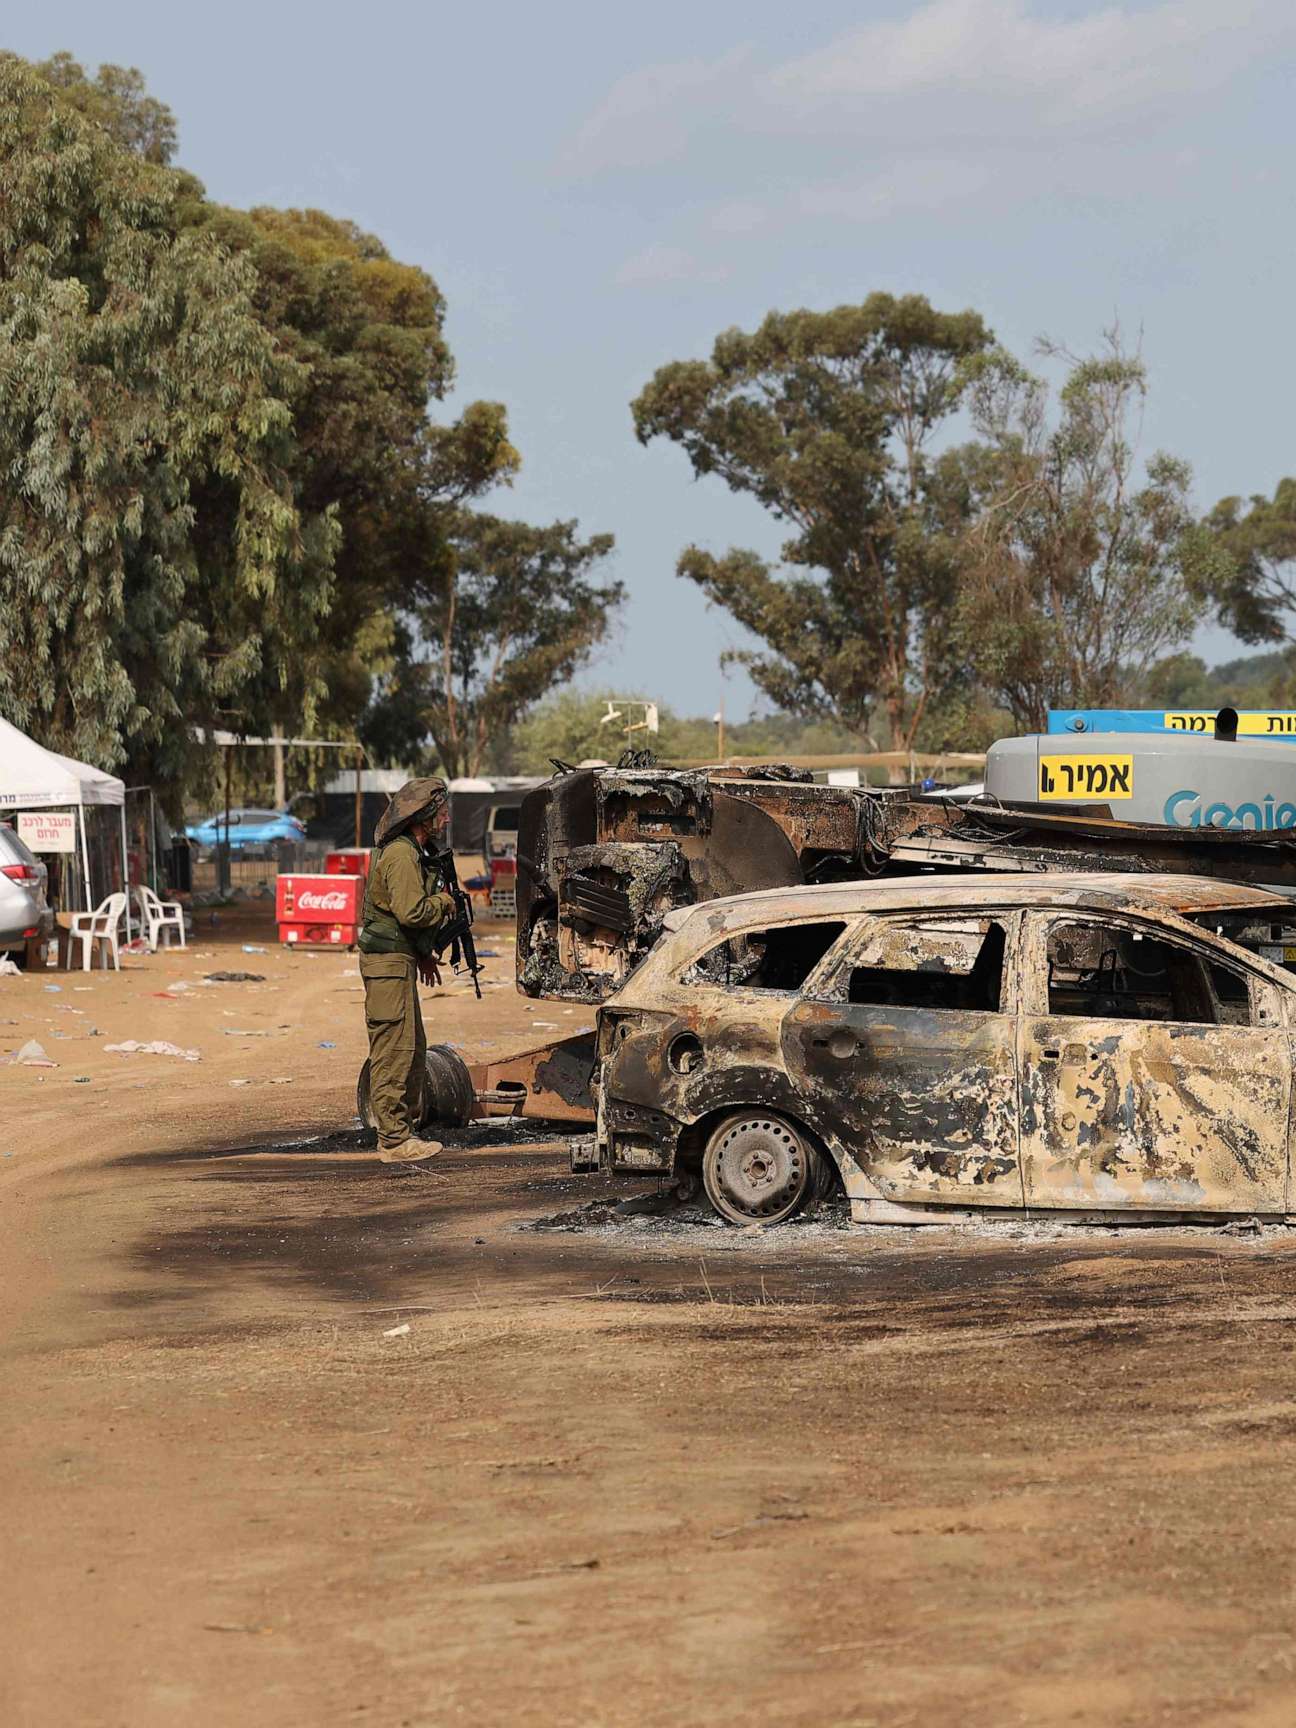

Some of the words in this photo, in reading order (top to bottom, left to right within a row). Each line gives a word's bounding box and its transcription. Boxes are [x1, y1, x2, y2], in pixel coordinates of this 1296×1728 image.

[1060, 764, 1130, 793] אמיר
[22, 815, 44, 828] לרכב
[46, 816, 72, 828] מעבר
[297, 890, 350, 910] CocaCola
